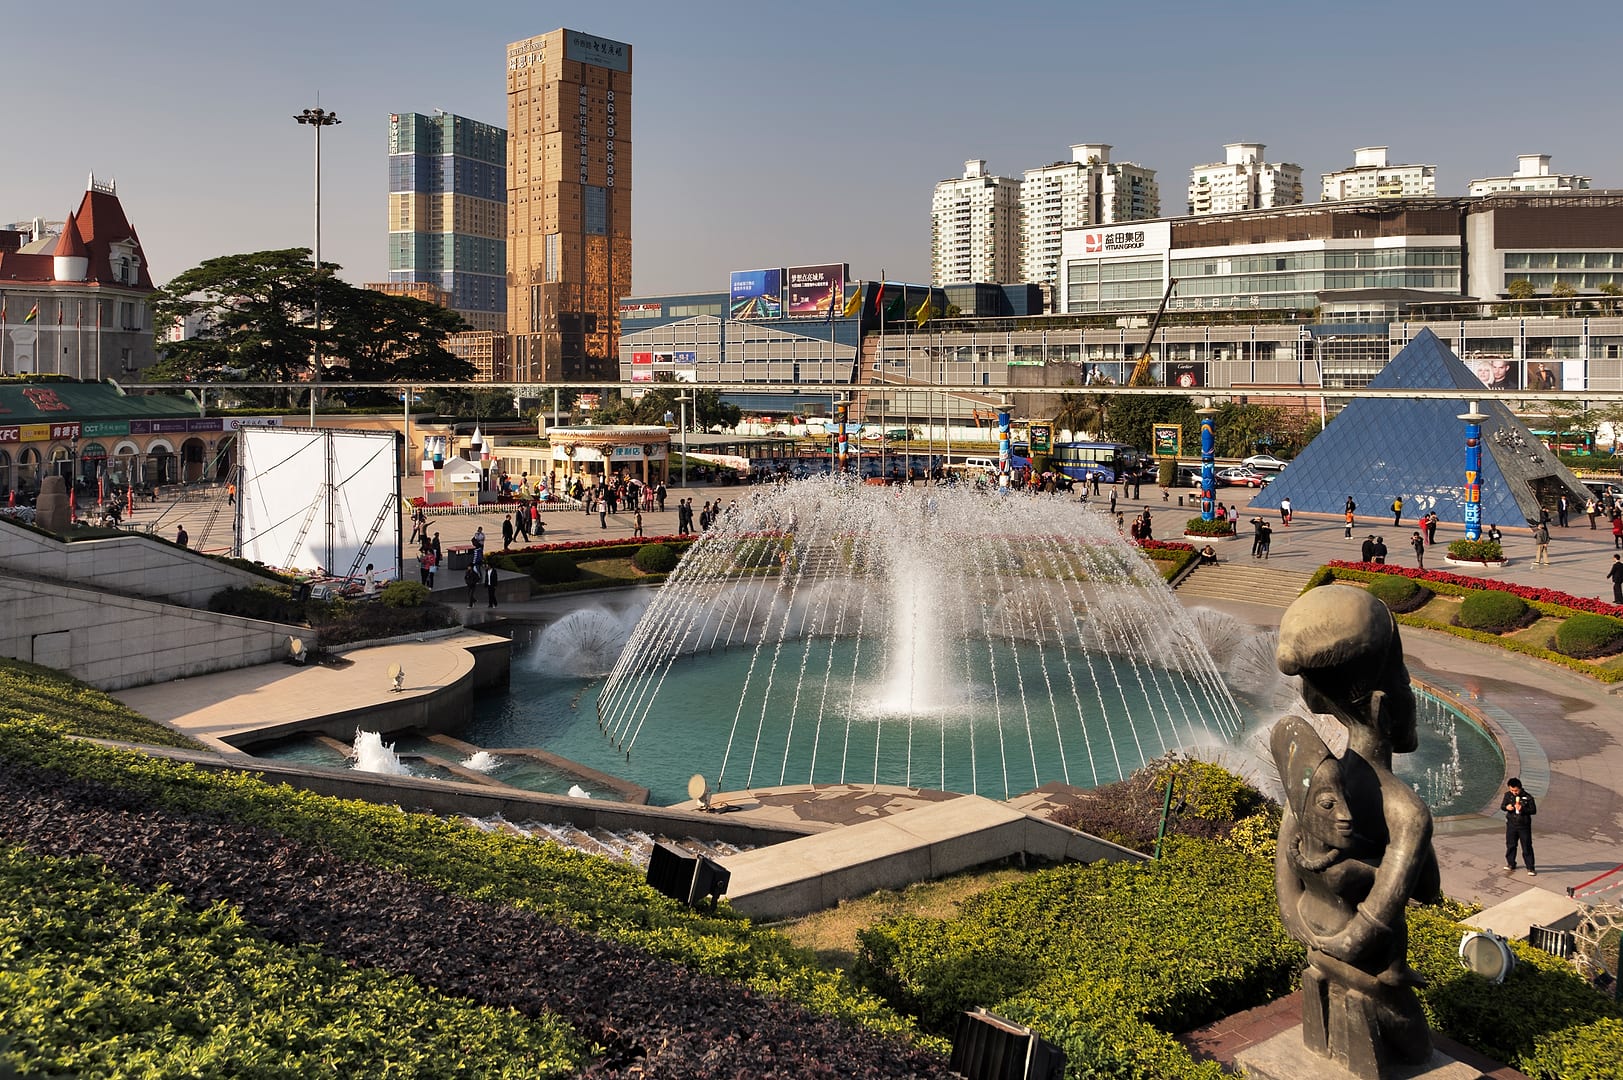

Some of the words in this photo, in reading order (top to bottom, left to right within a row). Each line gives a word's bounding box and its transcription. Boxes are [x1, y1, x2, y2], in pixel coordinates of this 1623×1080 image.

[607, 90, 615, 187] 86398888
[1105, 231, 1144, 244] 益田集团
